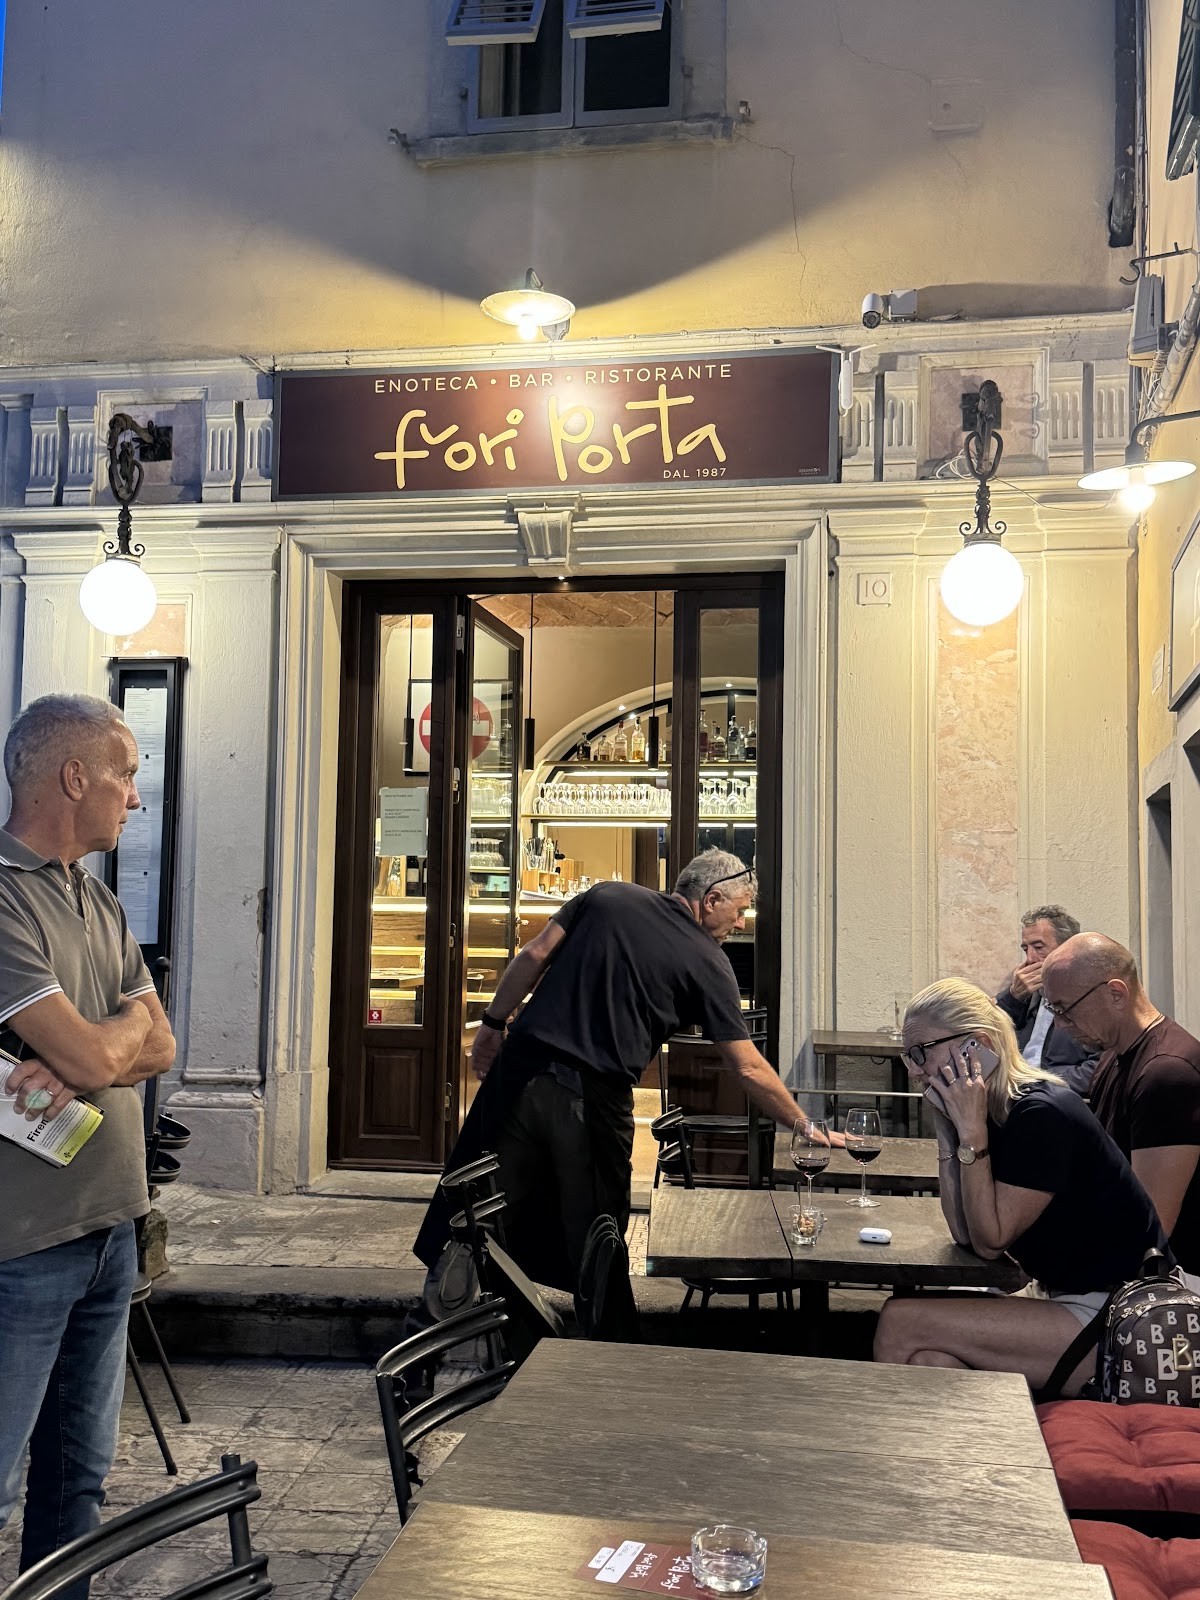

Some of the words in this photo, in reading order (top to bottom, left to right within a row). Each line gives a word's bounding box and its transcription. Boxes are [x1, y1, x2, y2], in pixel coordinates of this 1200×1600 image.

[375, 376, 478, 393] ENOTECA
[509, 372, 553, 388] BAR
[585, 363, 732, 385] RISTORANTE
[663, 469, 690, 479] DAL
[696, 467, 727, 477] 1987
[865, 579, 886, 596] 10
[26, 1118, 50, 1143] Firen
[1147, 1292, 1157, 1302] B
[1167, 1311, 1178, 1325] B
[1187, 1313, 1200, 1333] B
[1150, 1324, 1165, 1344] B
[1136, 1339, 1148, 1355] B
[1172, 1337, 1195, 1371] B
[1124, 1359, 1133, 1373] B
[1156, 1348, 1179, 1380] B
[1119, 1379, 1131, 1398] B
[1145, 1377, 1157, 1394] B
